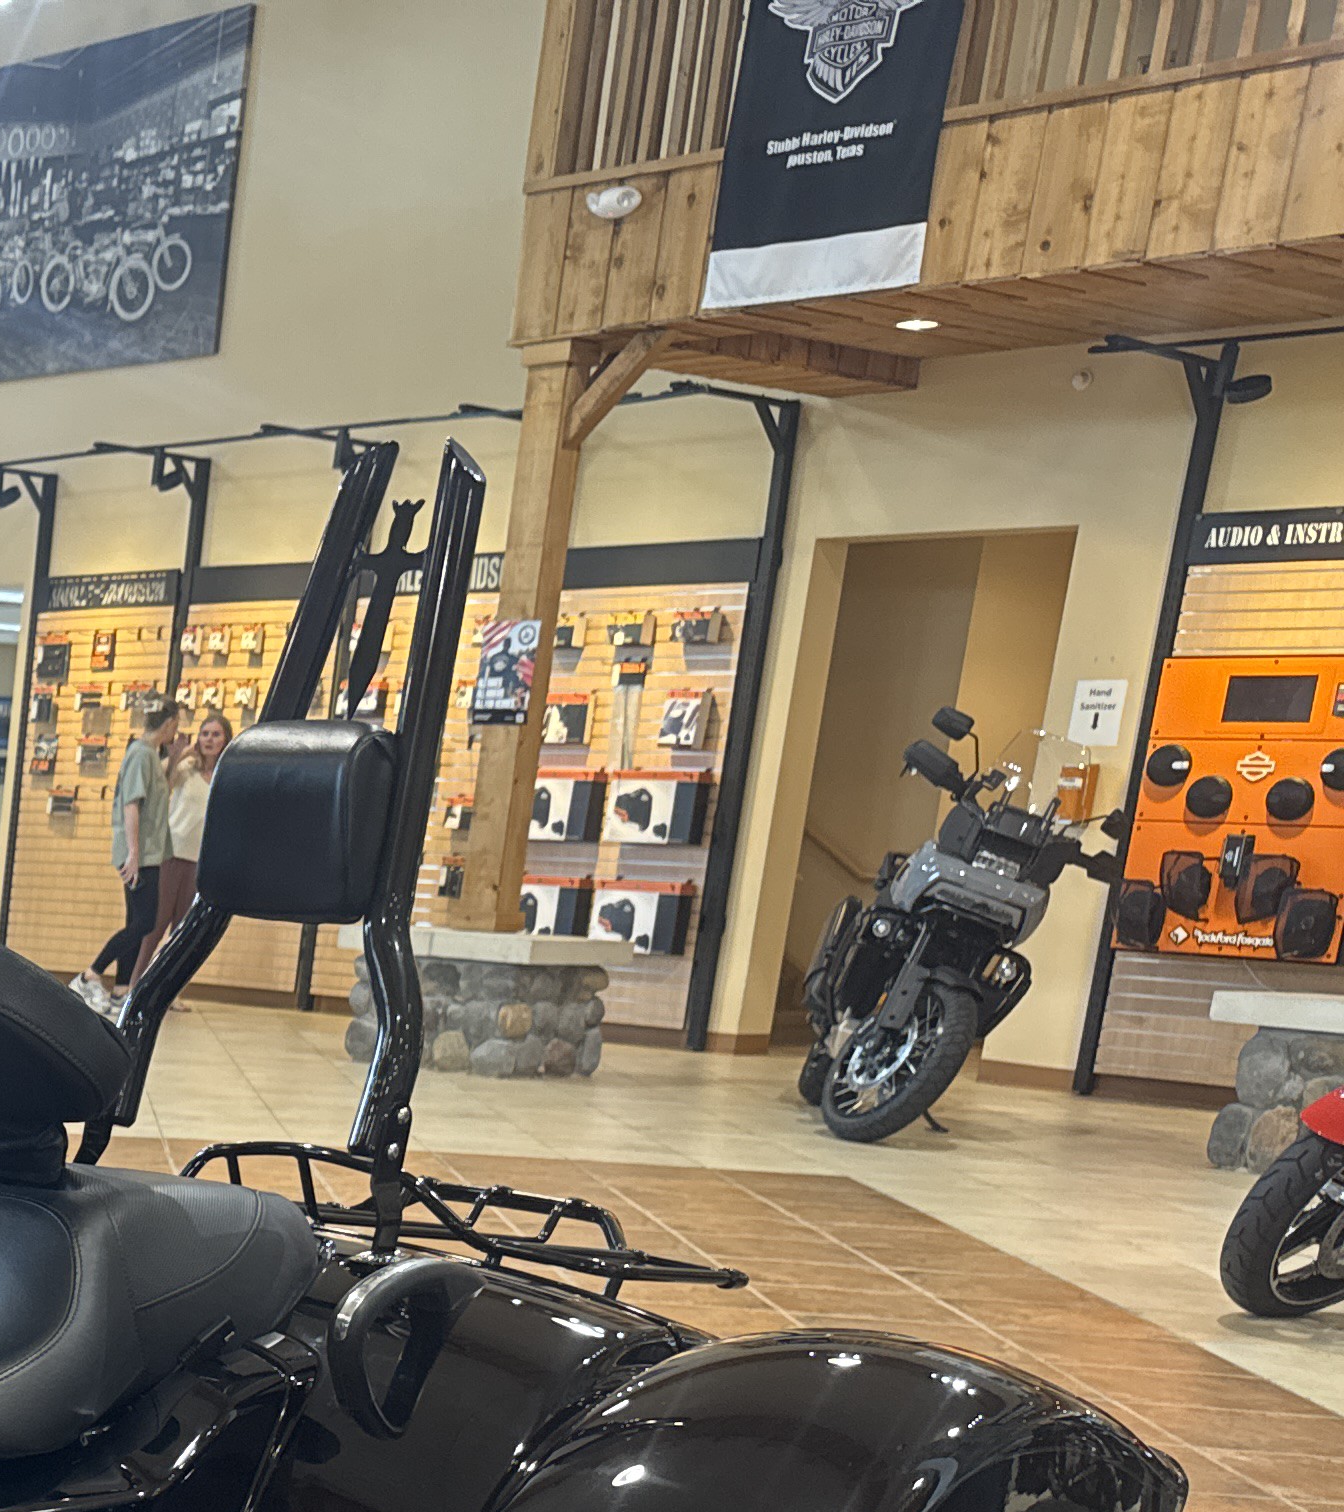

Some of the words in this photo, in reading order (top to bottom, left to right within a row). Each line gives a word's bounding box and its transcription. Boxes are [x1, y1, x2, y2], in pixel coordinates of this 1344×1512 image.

[766, 136, 800, 155] Stubbs
[1205, 525, 1263, 548] AUDIO
[1266, 524, 1281, 546] &
[1089, 687, 1113, 698] Hand
[1080, 701, 1117, 712] Sanitizer
